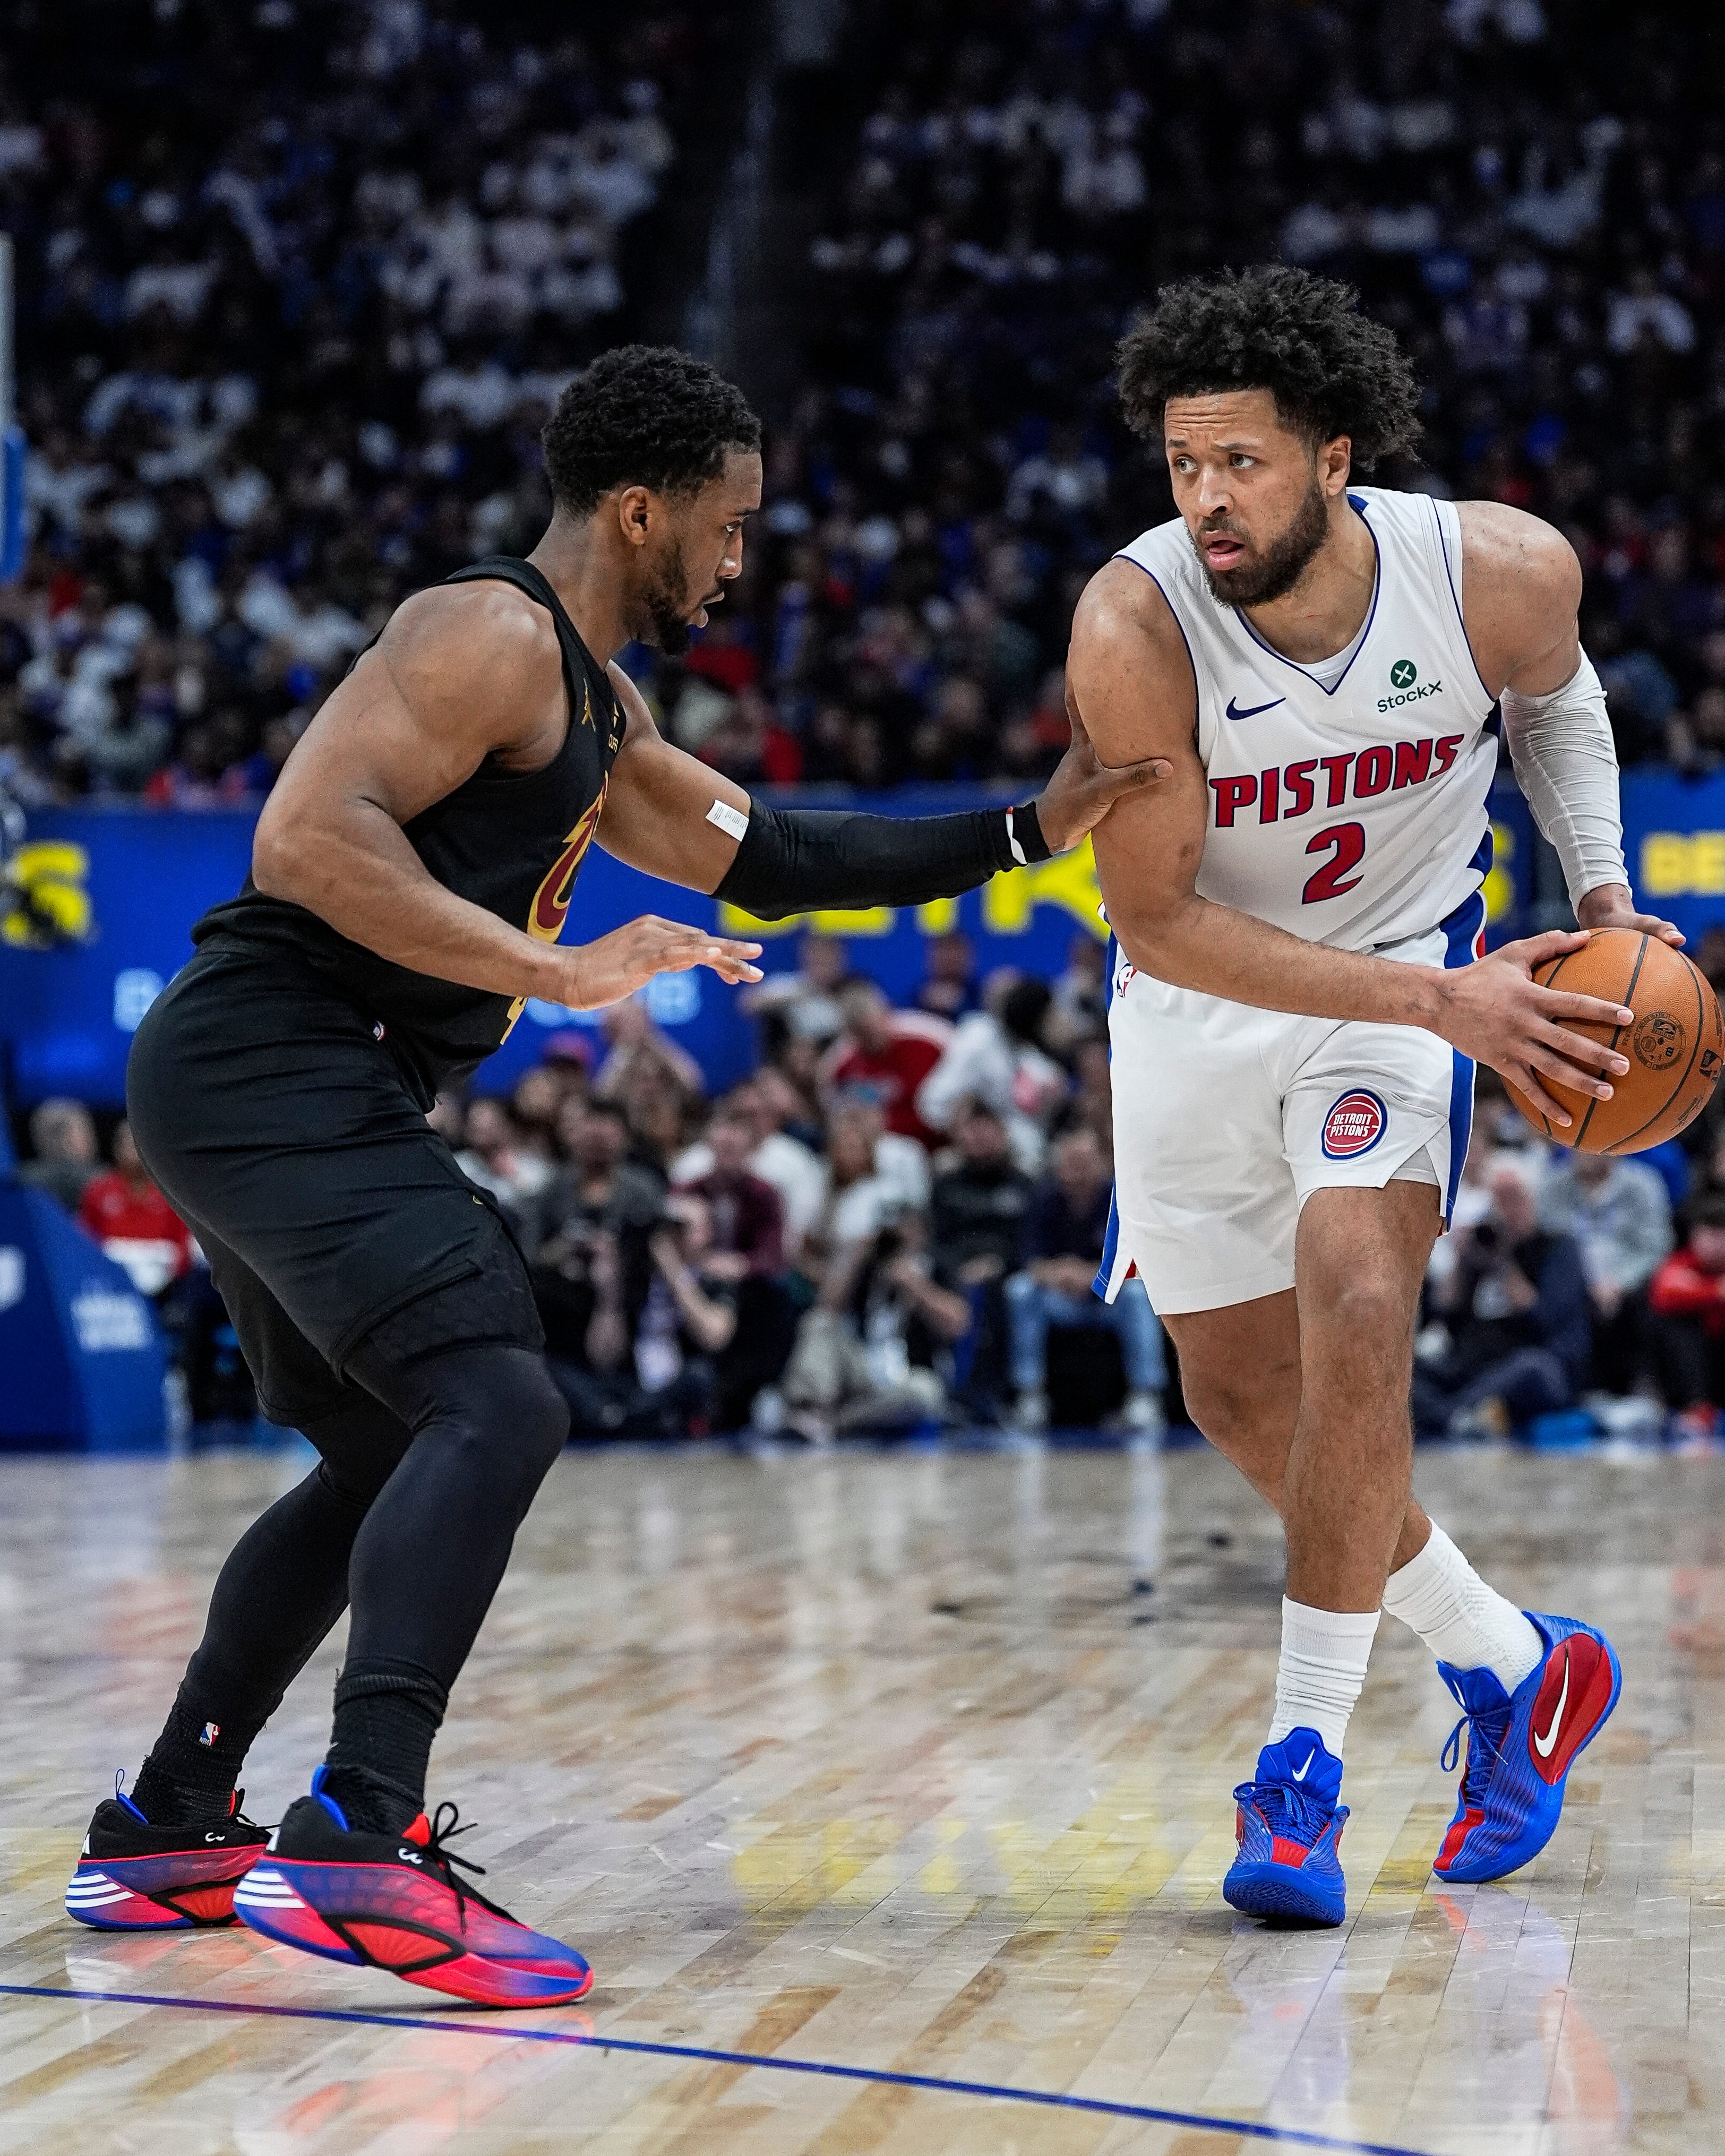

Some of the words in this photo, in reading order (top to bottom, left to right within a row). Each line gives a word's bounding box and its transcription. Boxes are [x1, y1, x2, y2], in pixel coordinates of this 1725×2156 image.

[1377, 680, 1443, 712] StockX
[1209, 734, 1464, 828] PISTONS
[1302, 822, 1365, 905] 2
[1329, 1125, 1370, 1137] PISTONS
[1333, 1113, 1374, 1125] DETROIT
